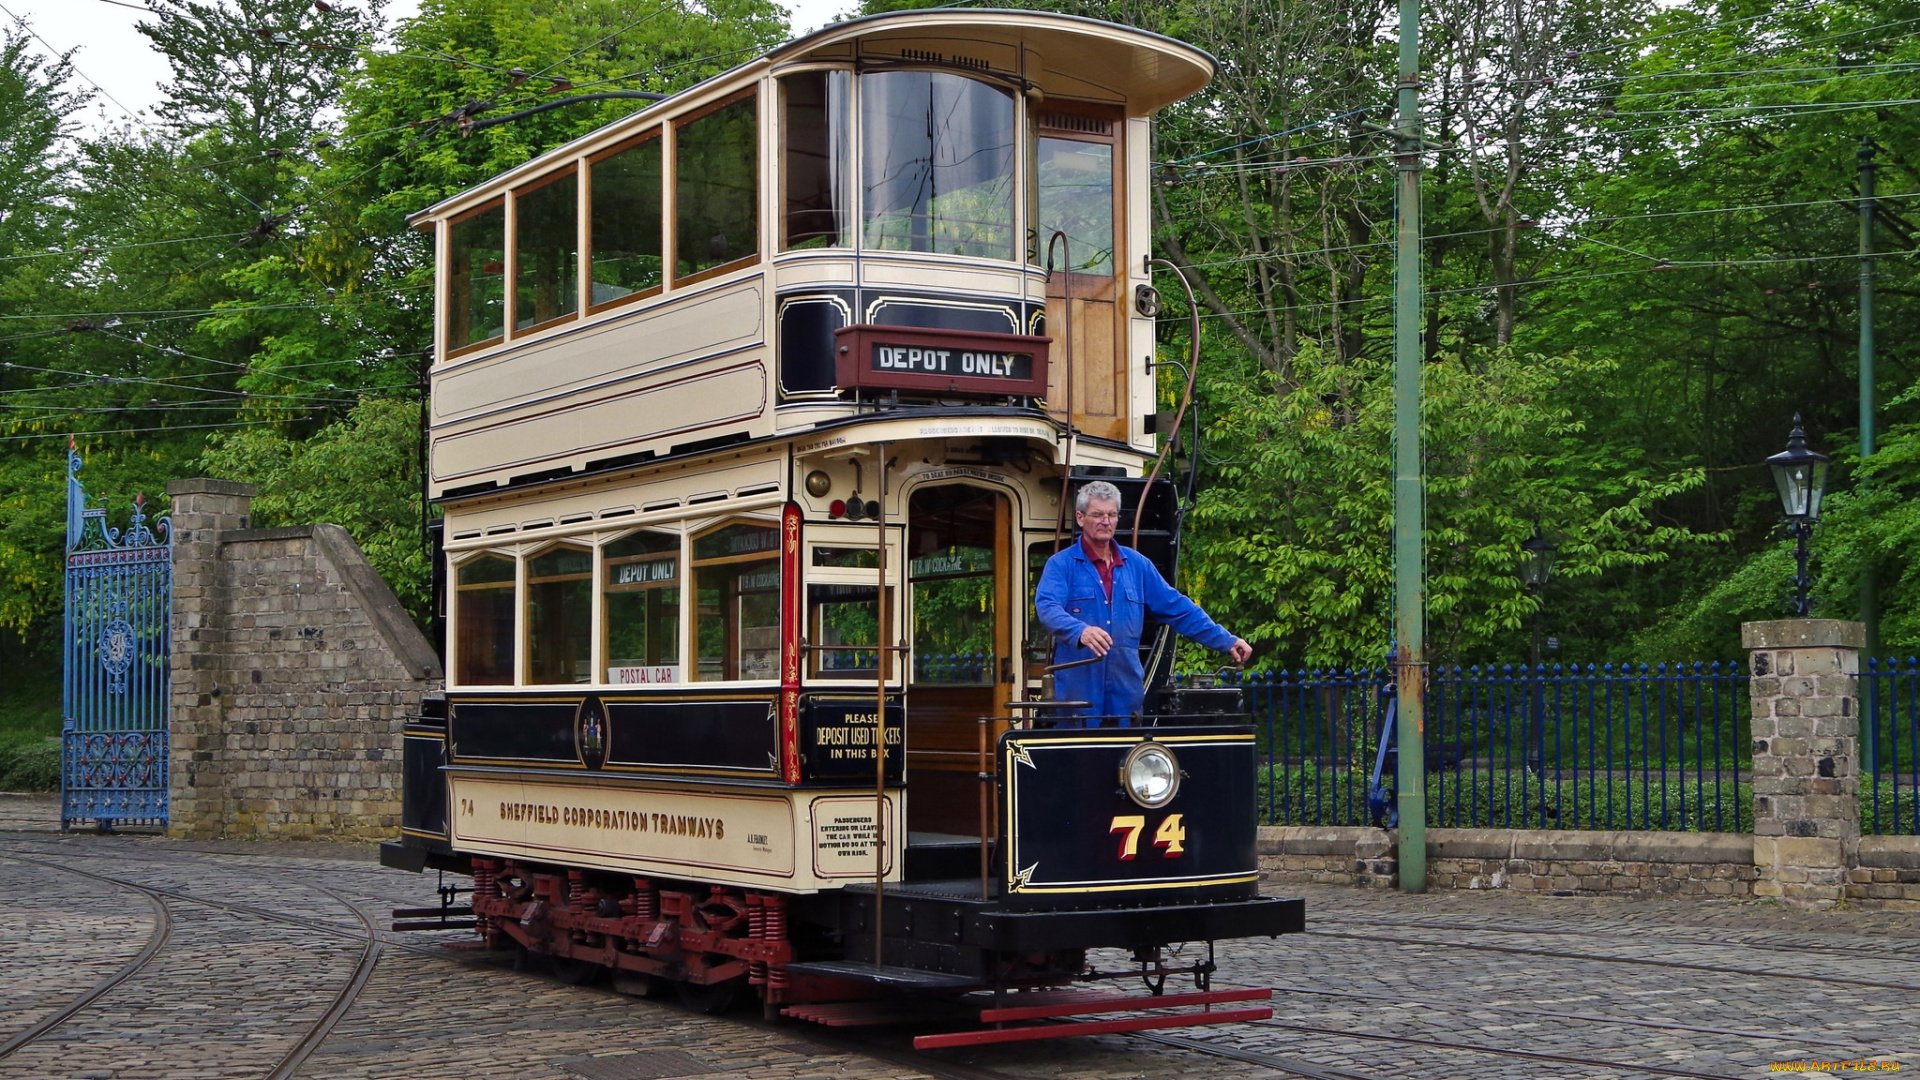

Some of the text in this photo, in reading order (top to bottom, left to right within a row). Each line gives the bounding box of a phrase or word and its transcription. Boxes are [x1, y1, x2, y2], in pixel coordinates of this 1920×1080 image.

[879, 346, 1015, 376] DEPOT ONLY
[619, 561, 675, 583] DEPOT ONLY
[620, 668, 672, 684] POSTAL CAR
[845, 713, 879, 723] PLEASE
[817, 727, 900, 745] DEPOSIT USED TIKETS
[831, 749, 889, 758] IN THIS BX
[461, 798, 474, 817] 74
[500, 802, 724, 841] SHEFFIELD CORPORATION TRAMWAYS
[1109, 813, 1186, 861] 74
